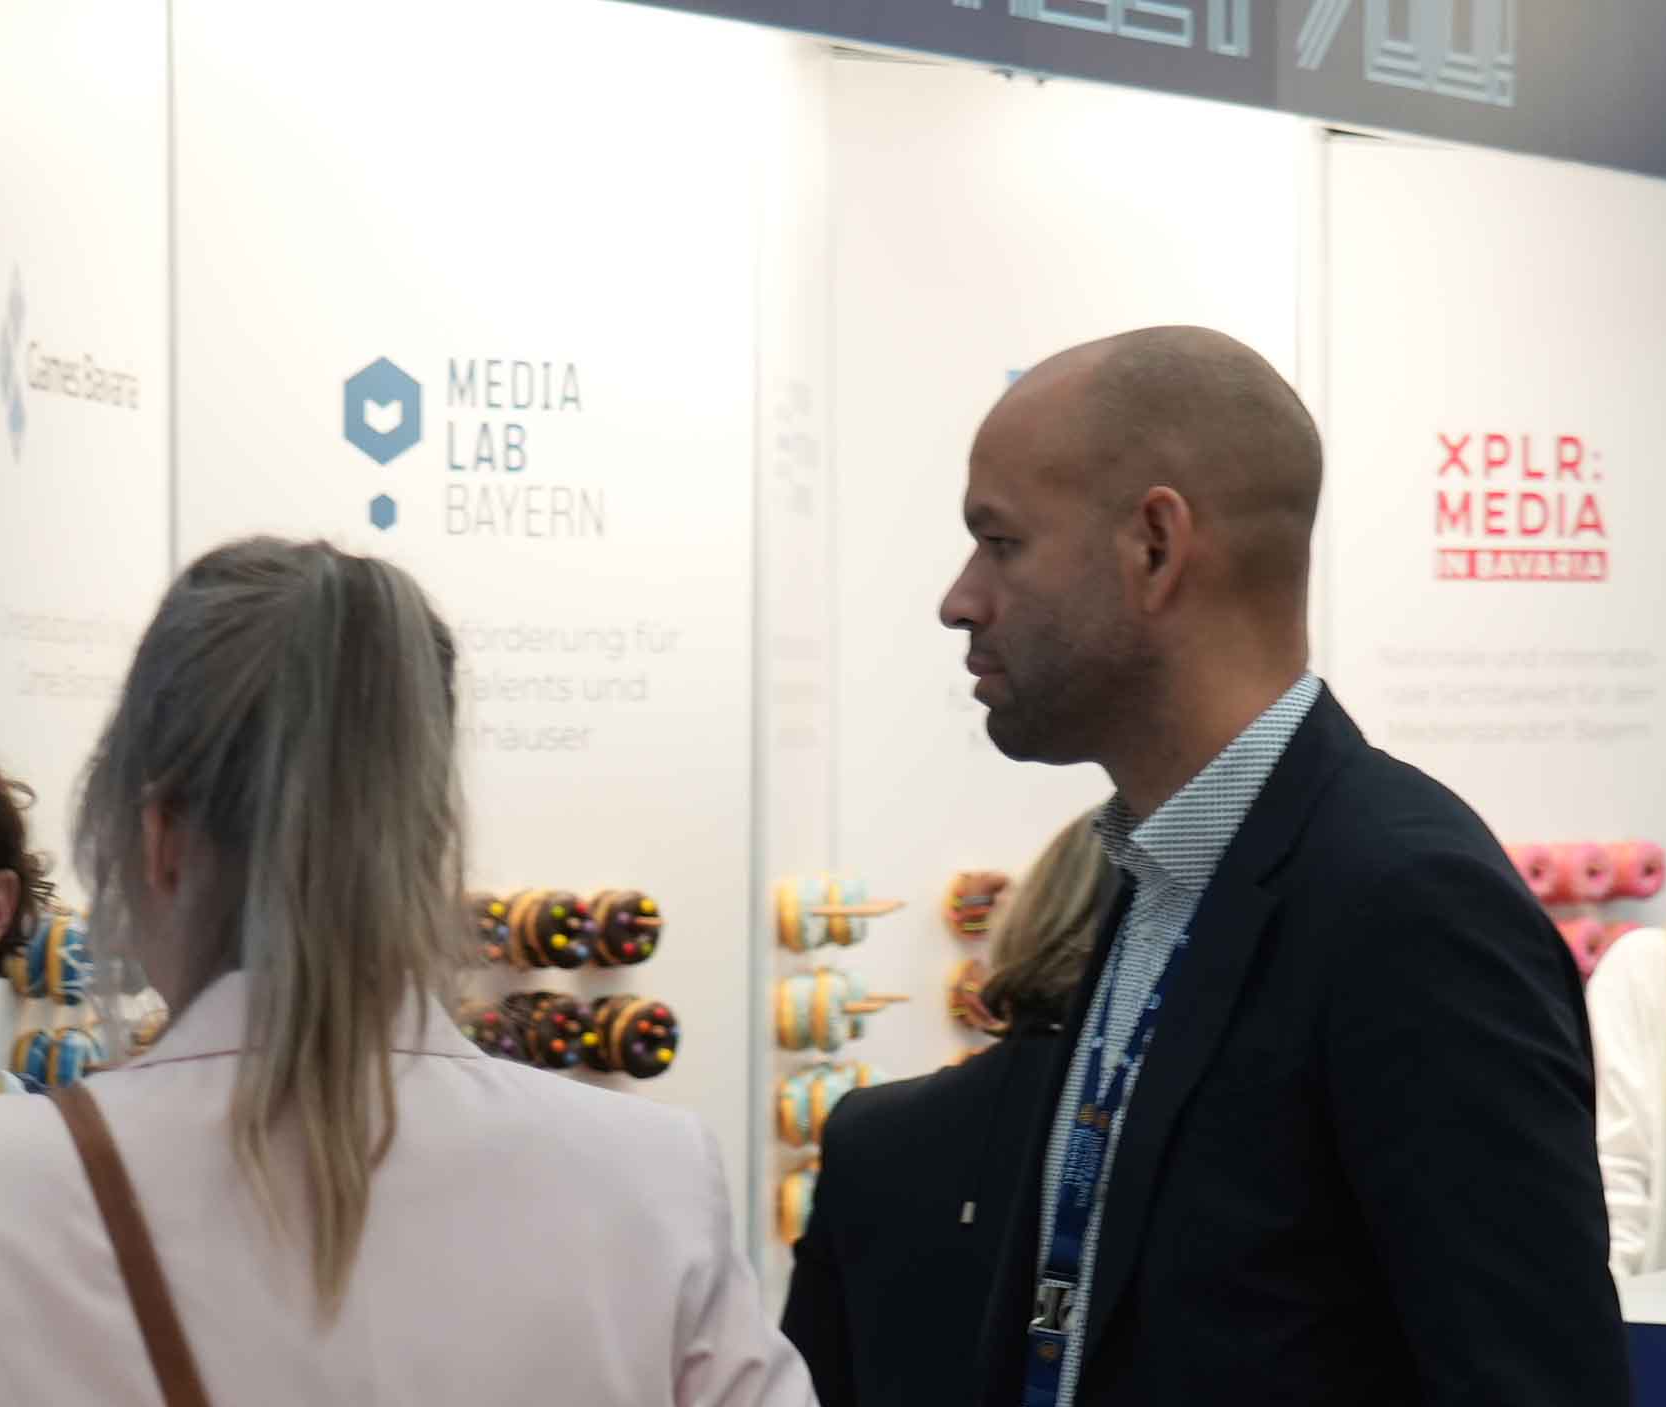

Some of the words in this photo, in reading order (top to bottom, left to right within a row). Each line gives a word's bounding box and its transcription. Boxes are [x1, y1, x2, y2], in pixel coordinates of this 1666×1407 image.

[448, 358, 582, 413] MEDIA
[448, 422, 528, 473] LAB
[1437, 433, 1604, 482] XPLR:
[446, 484, 606, 539] BAYERN
[1436, 491, 1607, 539] MEDIA
[583, 671, 647, 702] und
